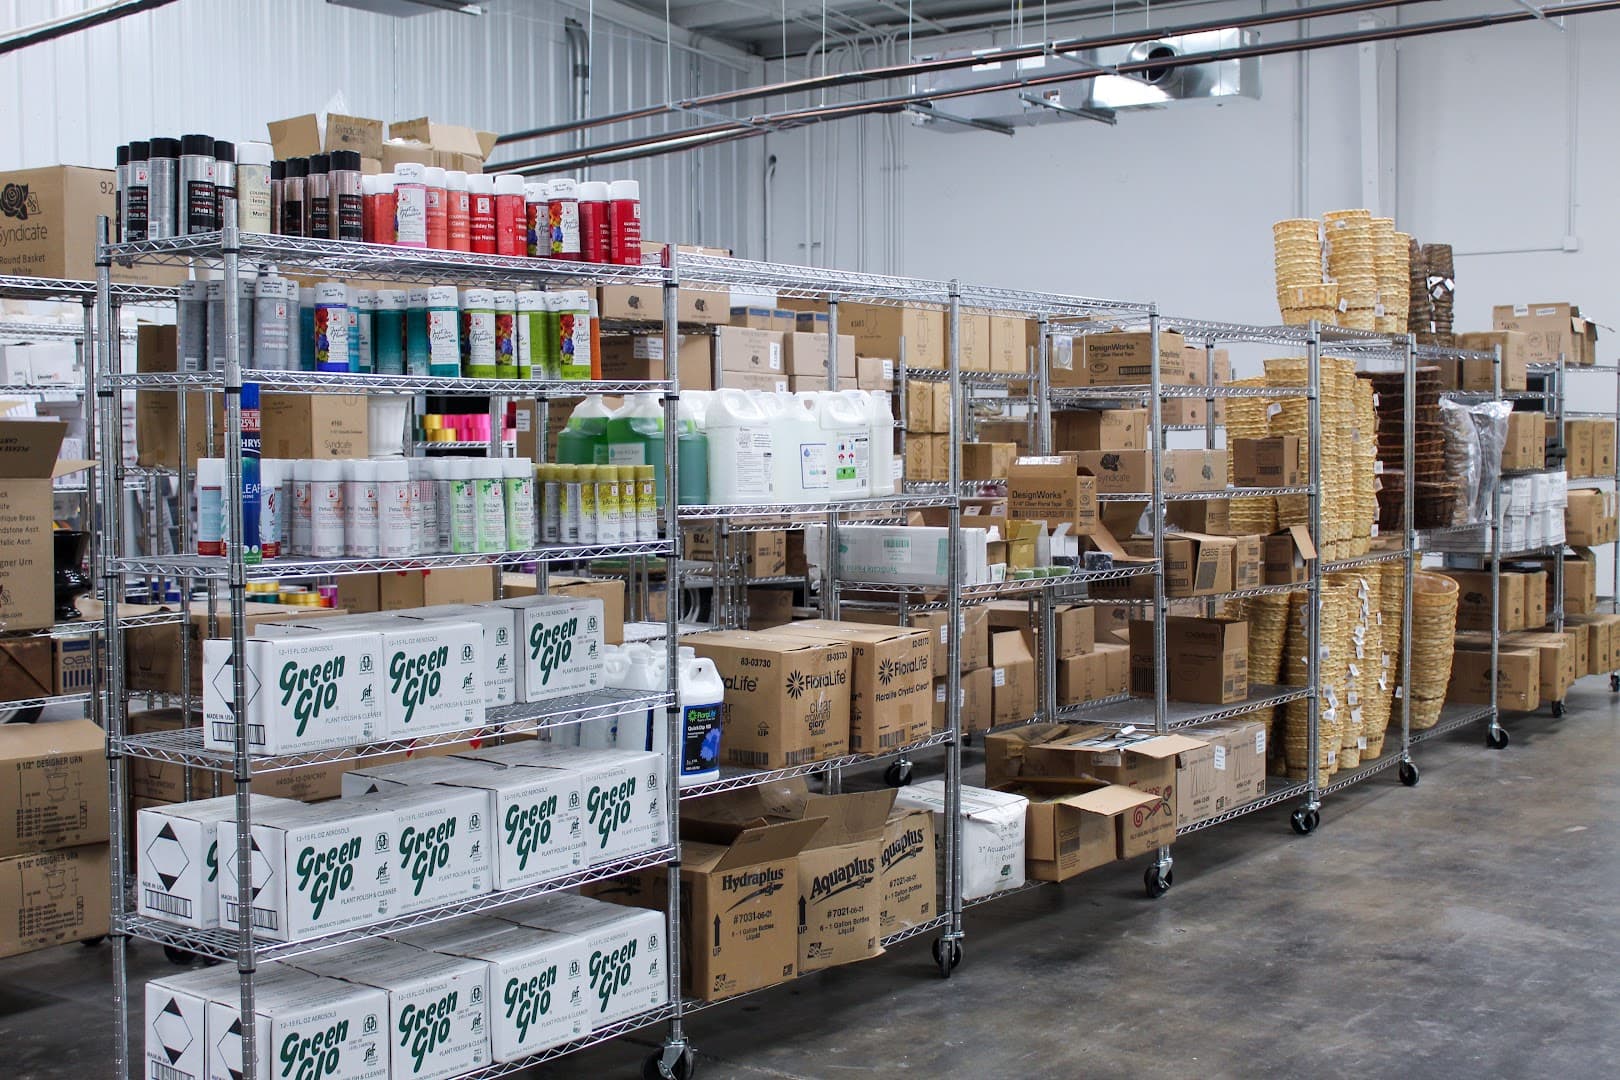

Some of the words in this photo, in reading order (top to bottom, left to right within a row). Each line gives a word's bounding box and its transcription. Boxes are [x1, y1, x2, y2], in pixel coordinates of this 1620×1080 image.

[101, 181, 114, 194] 92
[23, 254, 45, 263] Basket
[1012, 490, 1062, 499] DesignWorks
[0, 514, 17, 524] tique
[0, 525, 23, 534] ndstone
[19, 558, 33, 566] Urn
[530, 617, 578, 660] Green
[280, 656, 345, 706] Green
[390, 645, 448, 694] Green
[541, 640, 571, 685] Glo
[722, 675, 757, 692] raLife
[805, 669, 846, 690] FloraLife
[894, 656, 928, 677] FloraLife
[294, 682, 337, 737] Glo
[402, 671, 441, 723] Glo
[809, 720, 825, 731] glory
[37, 757, 69, 768] DESIGNER
[505, 795, 557, 844] Green
[587, 777, 636, 824] Green
[399, 816, 456, 869] Green
[517, 820, 551, 871] Glo
[599, 800, 630, 849] Glo
[297, 836, 362, 891] Green
[412, 842, 449, 896] Glo
[881, 828, 924, 867] quaplus
[310, 864, 353, 920] Glo
[341, 897, 356, 905] PLANT
[356, 893, 373, 902] POLISH
[377, 888, 397, 897] CLEANER
[722, 867, 784, 893] Hydraplus
[810, 857, 875, 900] Aquaplus
[798, 926, 807, 934] UP
[834, 920, 852, 929] Gallon
[853, 916, 869, 925] Bottles
[838, 926, 855, 935] Liquid
[589, 938, 637, 989] Green
[713, 947, 721, 957] UP
[504, 965, 557, 1018] Green
[599, 962, 631, 1013] Glo
[399, 991, 458, 1047] Green
[516, 990, 551, 1043] Glo
[280, 1019, 349, 1077] Green
[412, 1017, 450, 1073] Glo
[365, 1069, 386, 1078] CLEANER
